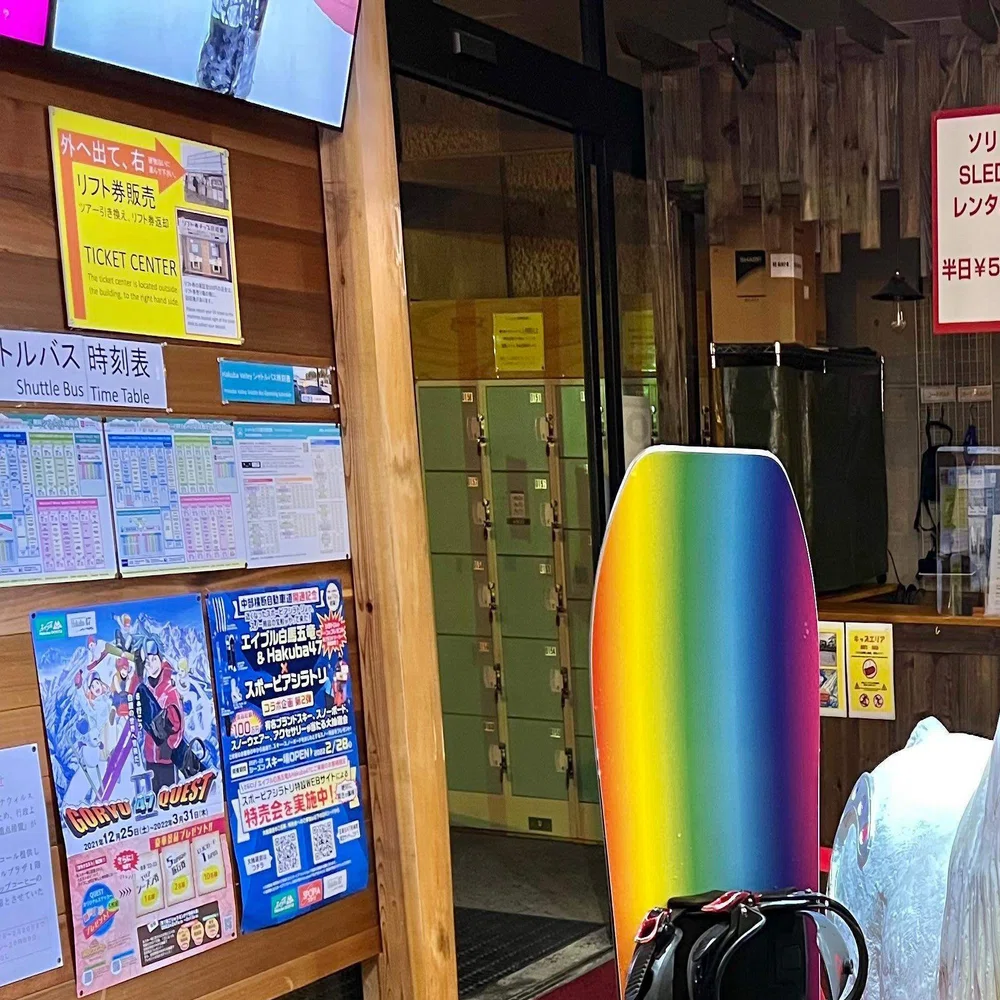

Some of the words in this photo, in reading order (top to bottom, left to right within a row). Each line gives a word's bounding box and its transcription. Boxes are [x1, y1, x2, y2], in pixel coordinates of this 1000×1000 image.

[60, 133, 145, 172] 外へ出て、右
[968, 130, 997, 153] ソリ
[77, 174, 156, 209] リフト券販売
[84, 245, 126, 269] TICKET
[130, 253, 178, 277] CENTER
[88, 273, 98, 281] The
[100, 274, 114, 285] ticket
[115, 278, 132, 287] center
[133, 280, 138, 288] is
[139, 281, 158, 291] located
[159, 285, 178, 294] outside
[89, 287, 98, 296] the
[131, 293, 139, 301] the
[140, 294, 153, 304] right
[154, 295, 167, 305] hand
[0, 338, 80, 369] トルバス
[88, 343, 150, 378] 時刻表
[16, 379, 60, 397] Shuttle
[64, 381, 84, 397] Bus
[90, 386, 118, 403] Time
[121, 388, 150, 404] Table
[241, 623, 317, 650] エイブル白馬五竜
[256, 650, 266, 665] &
[266, 639, 323, 662] Hakuba47
[65, 801, 132, 838] GORYU
[135, 792, 156, 814] 47
[158, 771, 218, 812] QUEST
[244, 785, 335, 829] 特売会を実施中!
